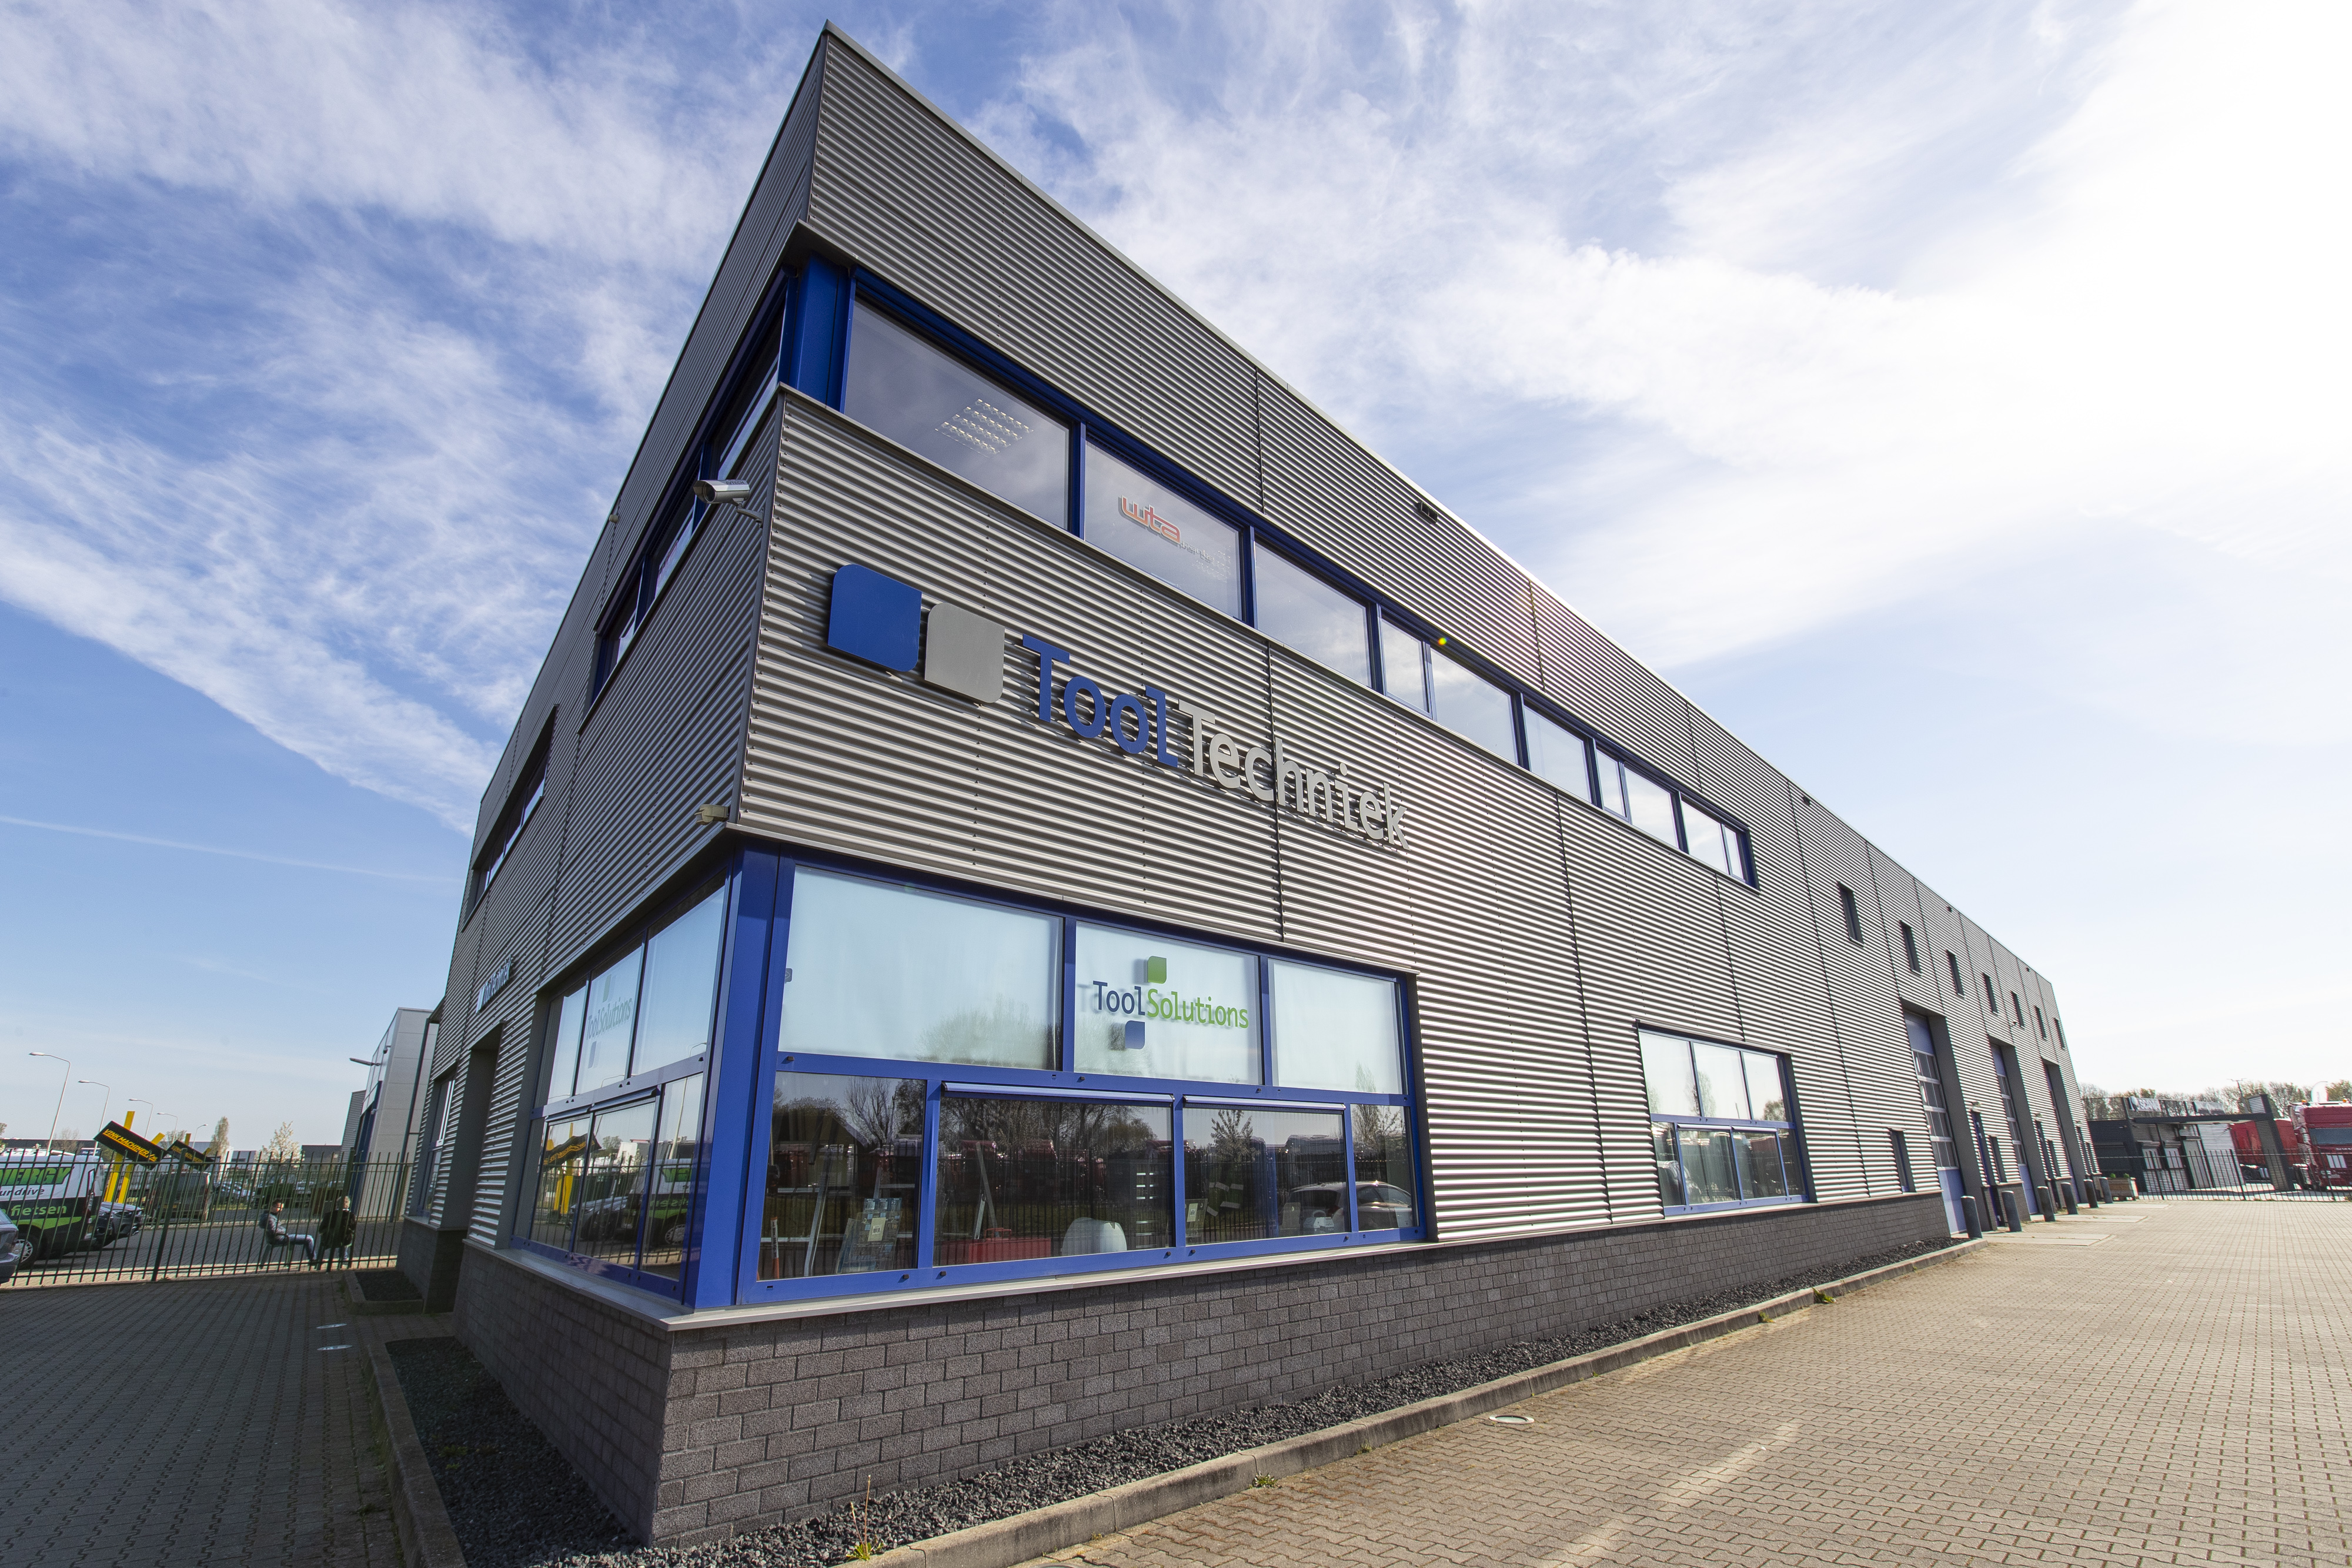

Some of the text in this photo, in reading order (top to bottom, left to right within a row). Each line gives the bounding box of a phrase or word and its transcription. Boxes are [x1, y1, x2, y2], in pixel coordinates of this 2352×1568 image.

[1023, 634, 1409, 850] ToolTechniek
[586, 997, 632, 1040] ToolSolutions
[1093, 980, 1249, 1028] ToolSolutions
[11, 1205, 67, 1216] fietsen
